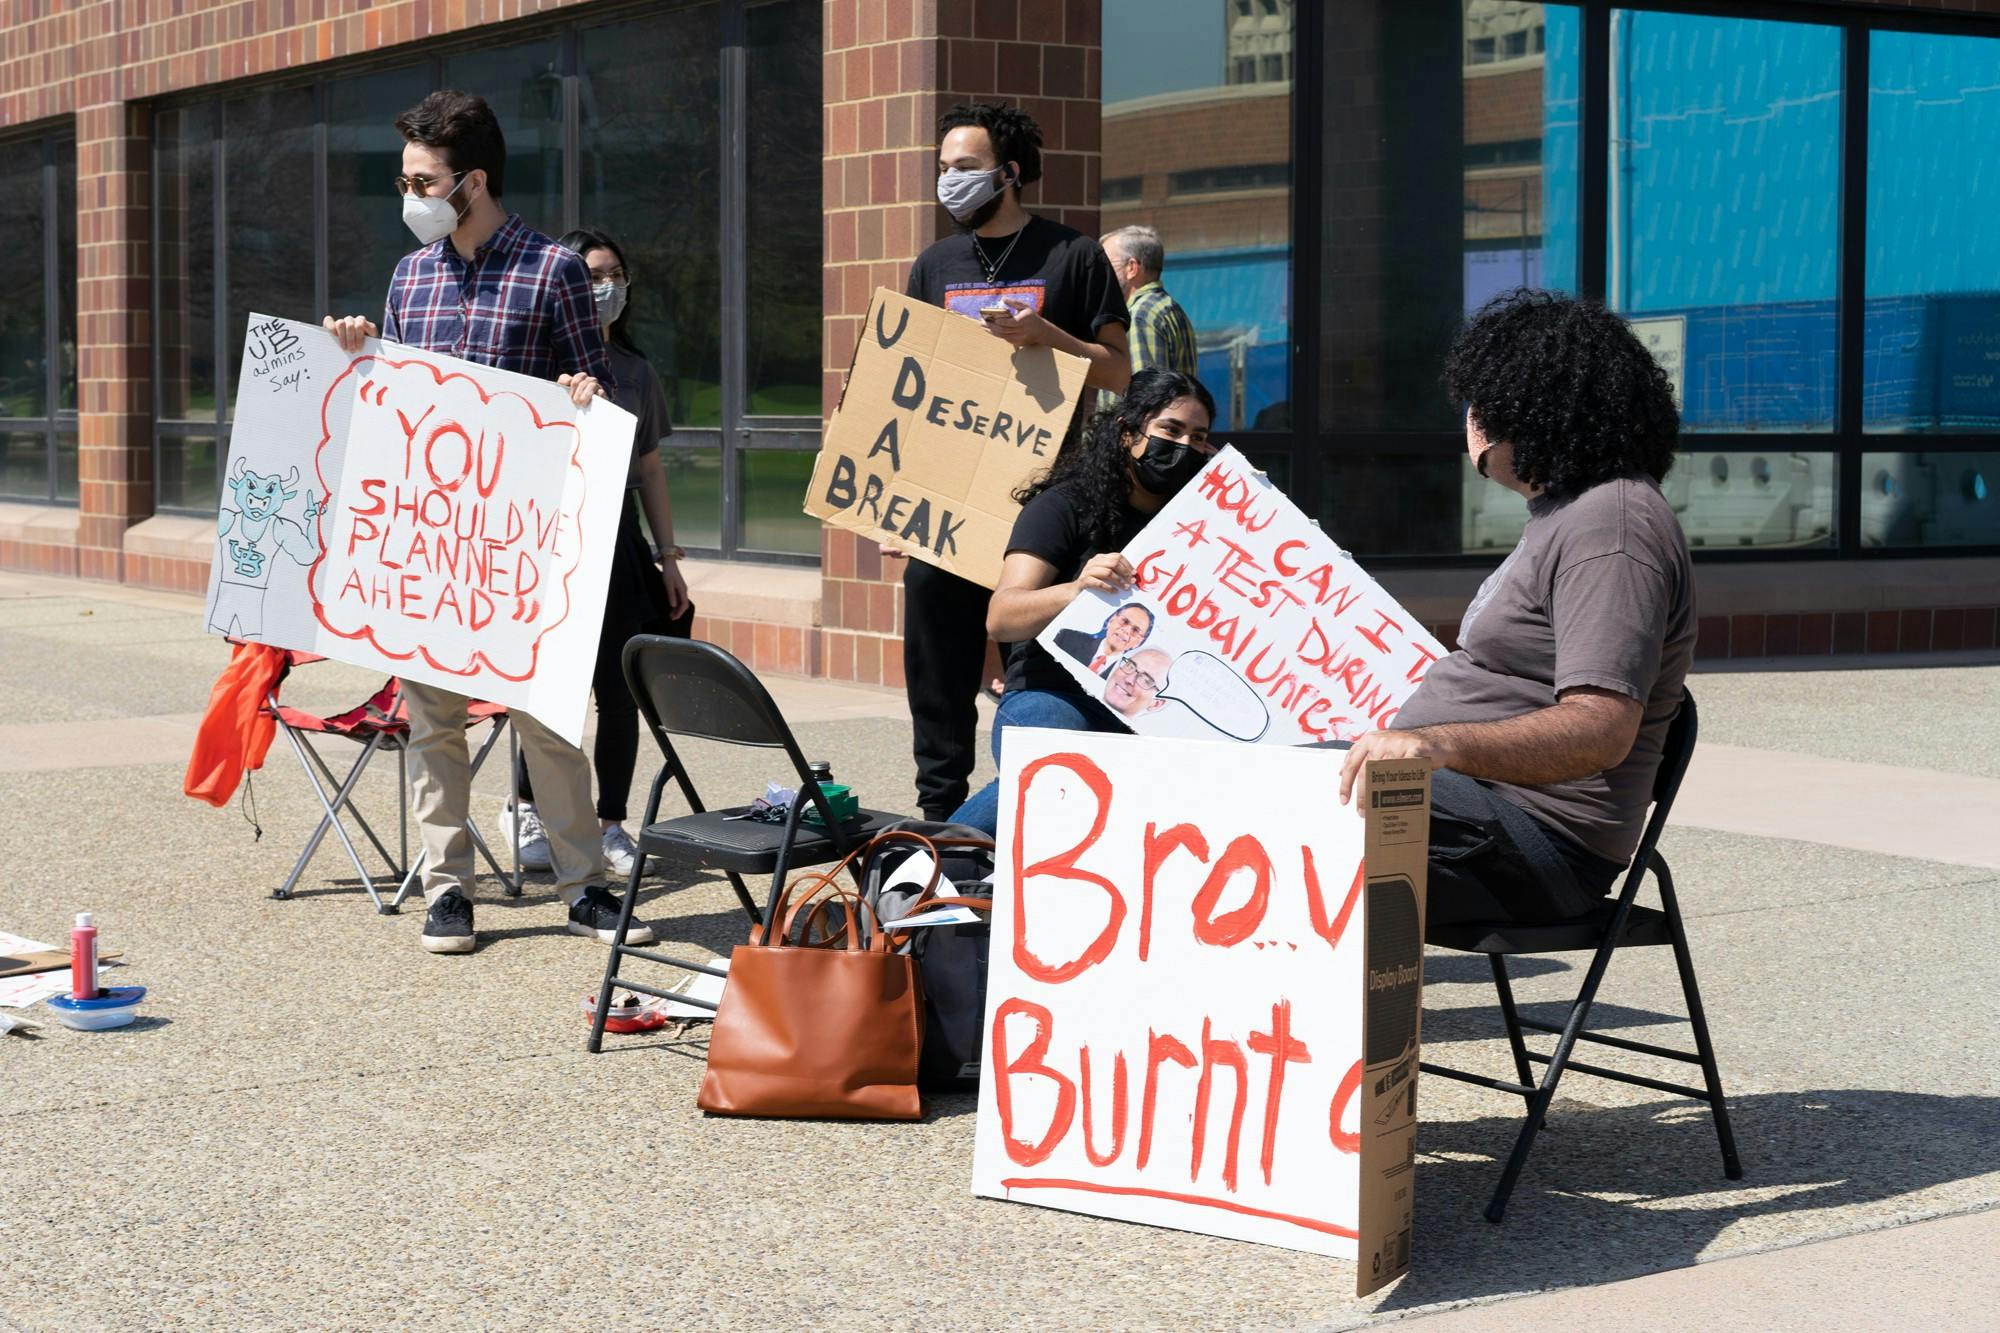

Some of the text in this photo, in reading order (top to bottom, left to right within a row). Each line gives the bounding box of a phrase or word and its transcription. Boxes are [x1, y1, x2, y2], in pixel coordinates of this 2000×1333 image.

[249, 318, 286, 337] THE
[249, 329, 299, 360] UB
[253, 346, 306, 377] admins
[876, 301, 910, 349] U
[867, 418, 900, 472] A
[892, 356, 1052, 456] DESERVE
[347, 478, 569, 558] SHOULD'VE
[825, 455, 966, 557] BREAK
[347, 516, 541, 621] PLANNED
[1171, 519, 1210, 549] A
[1212, 536, 1307, 618] TEST
[1198, 461, 1278, 534] HOW
[1273, 539, 1365, 617] CAN
[1355, 609, 1404, 654] I
[1244, 641, 1369, 743] Unres
[1369, 960, 1418, 992] Display Board
[992, 997, 1313, 1194] Burnt
